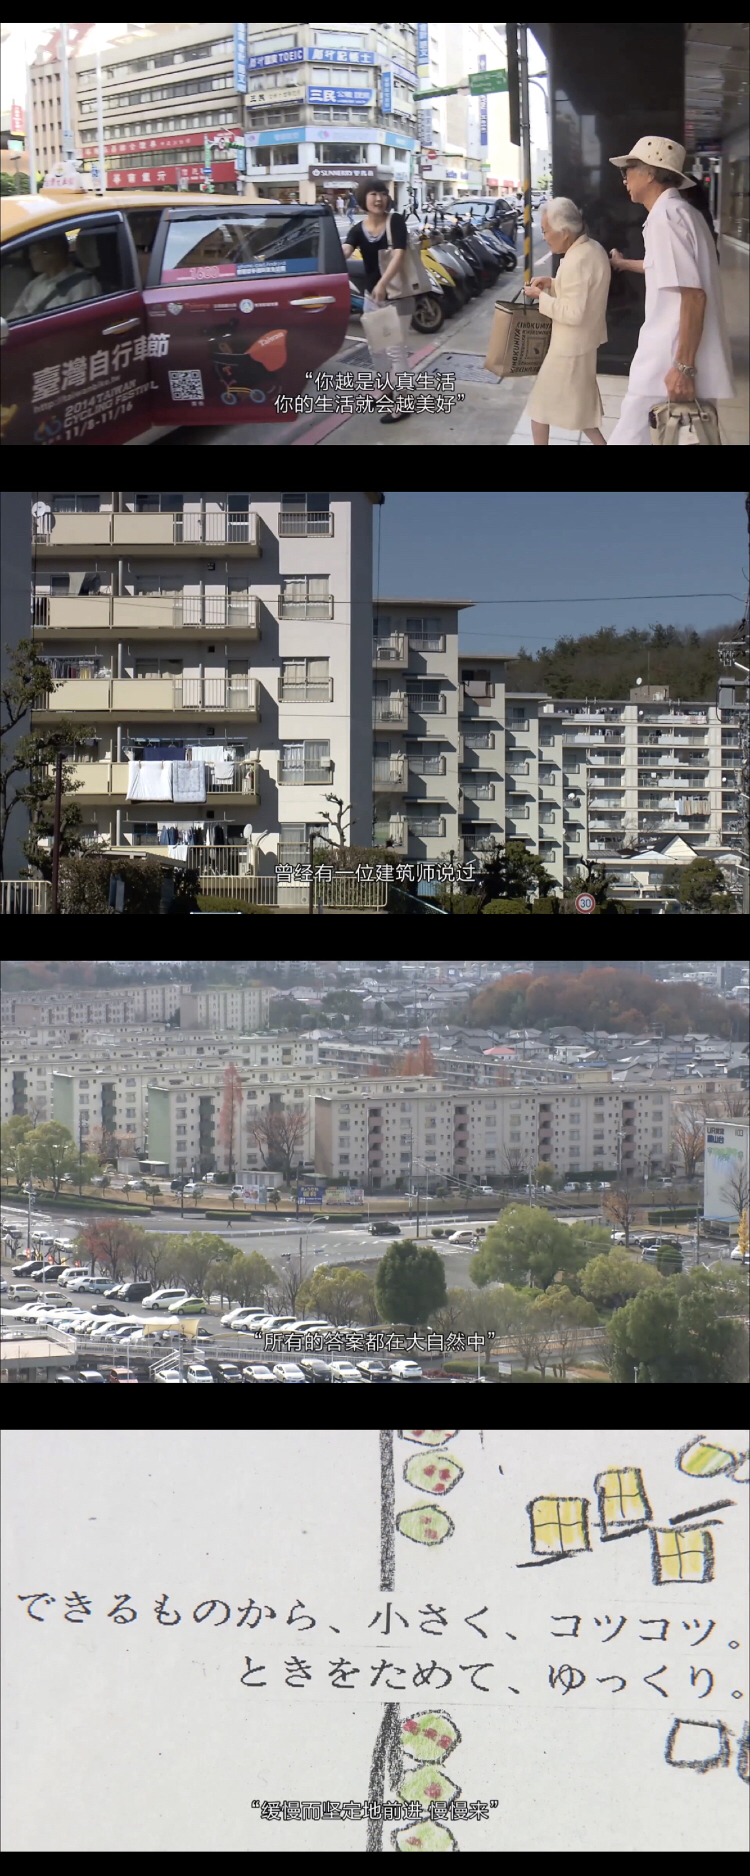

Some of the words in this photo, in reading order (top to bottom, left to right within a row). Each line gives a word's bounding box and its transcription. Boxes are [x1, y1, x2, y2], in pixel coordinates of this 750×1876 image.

[31, 333, 170, 403] 臺灣自行車節
[64, 399, 113, 428] CYCLING
[114, 381, 159, 405] FESTIVL
[65, 398, 97, 418] 2014
[96, 379, 137, 403] TAIWAN
[580, 898, 591, 908] 30
